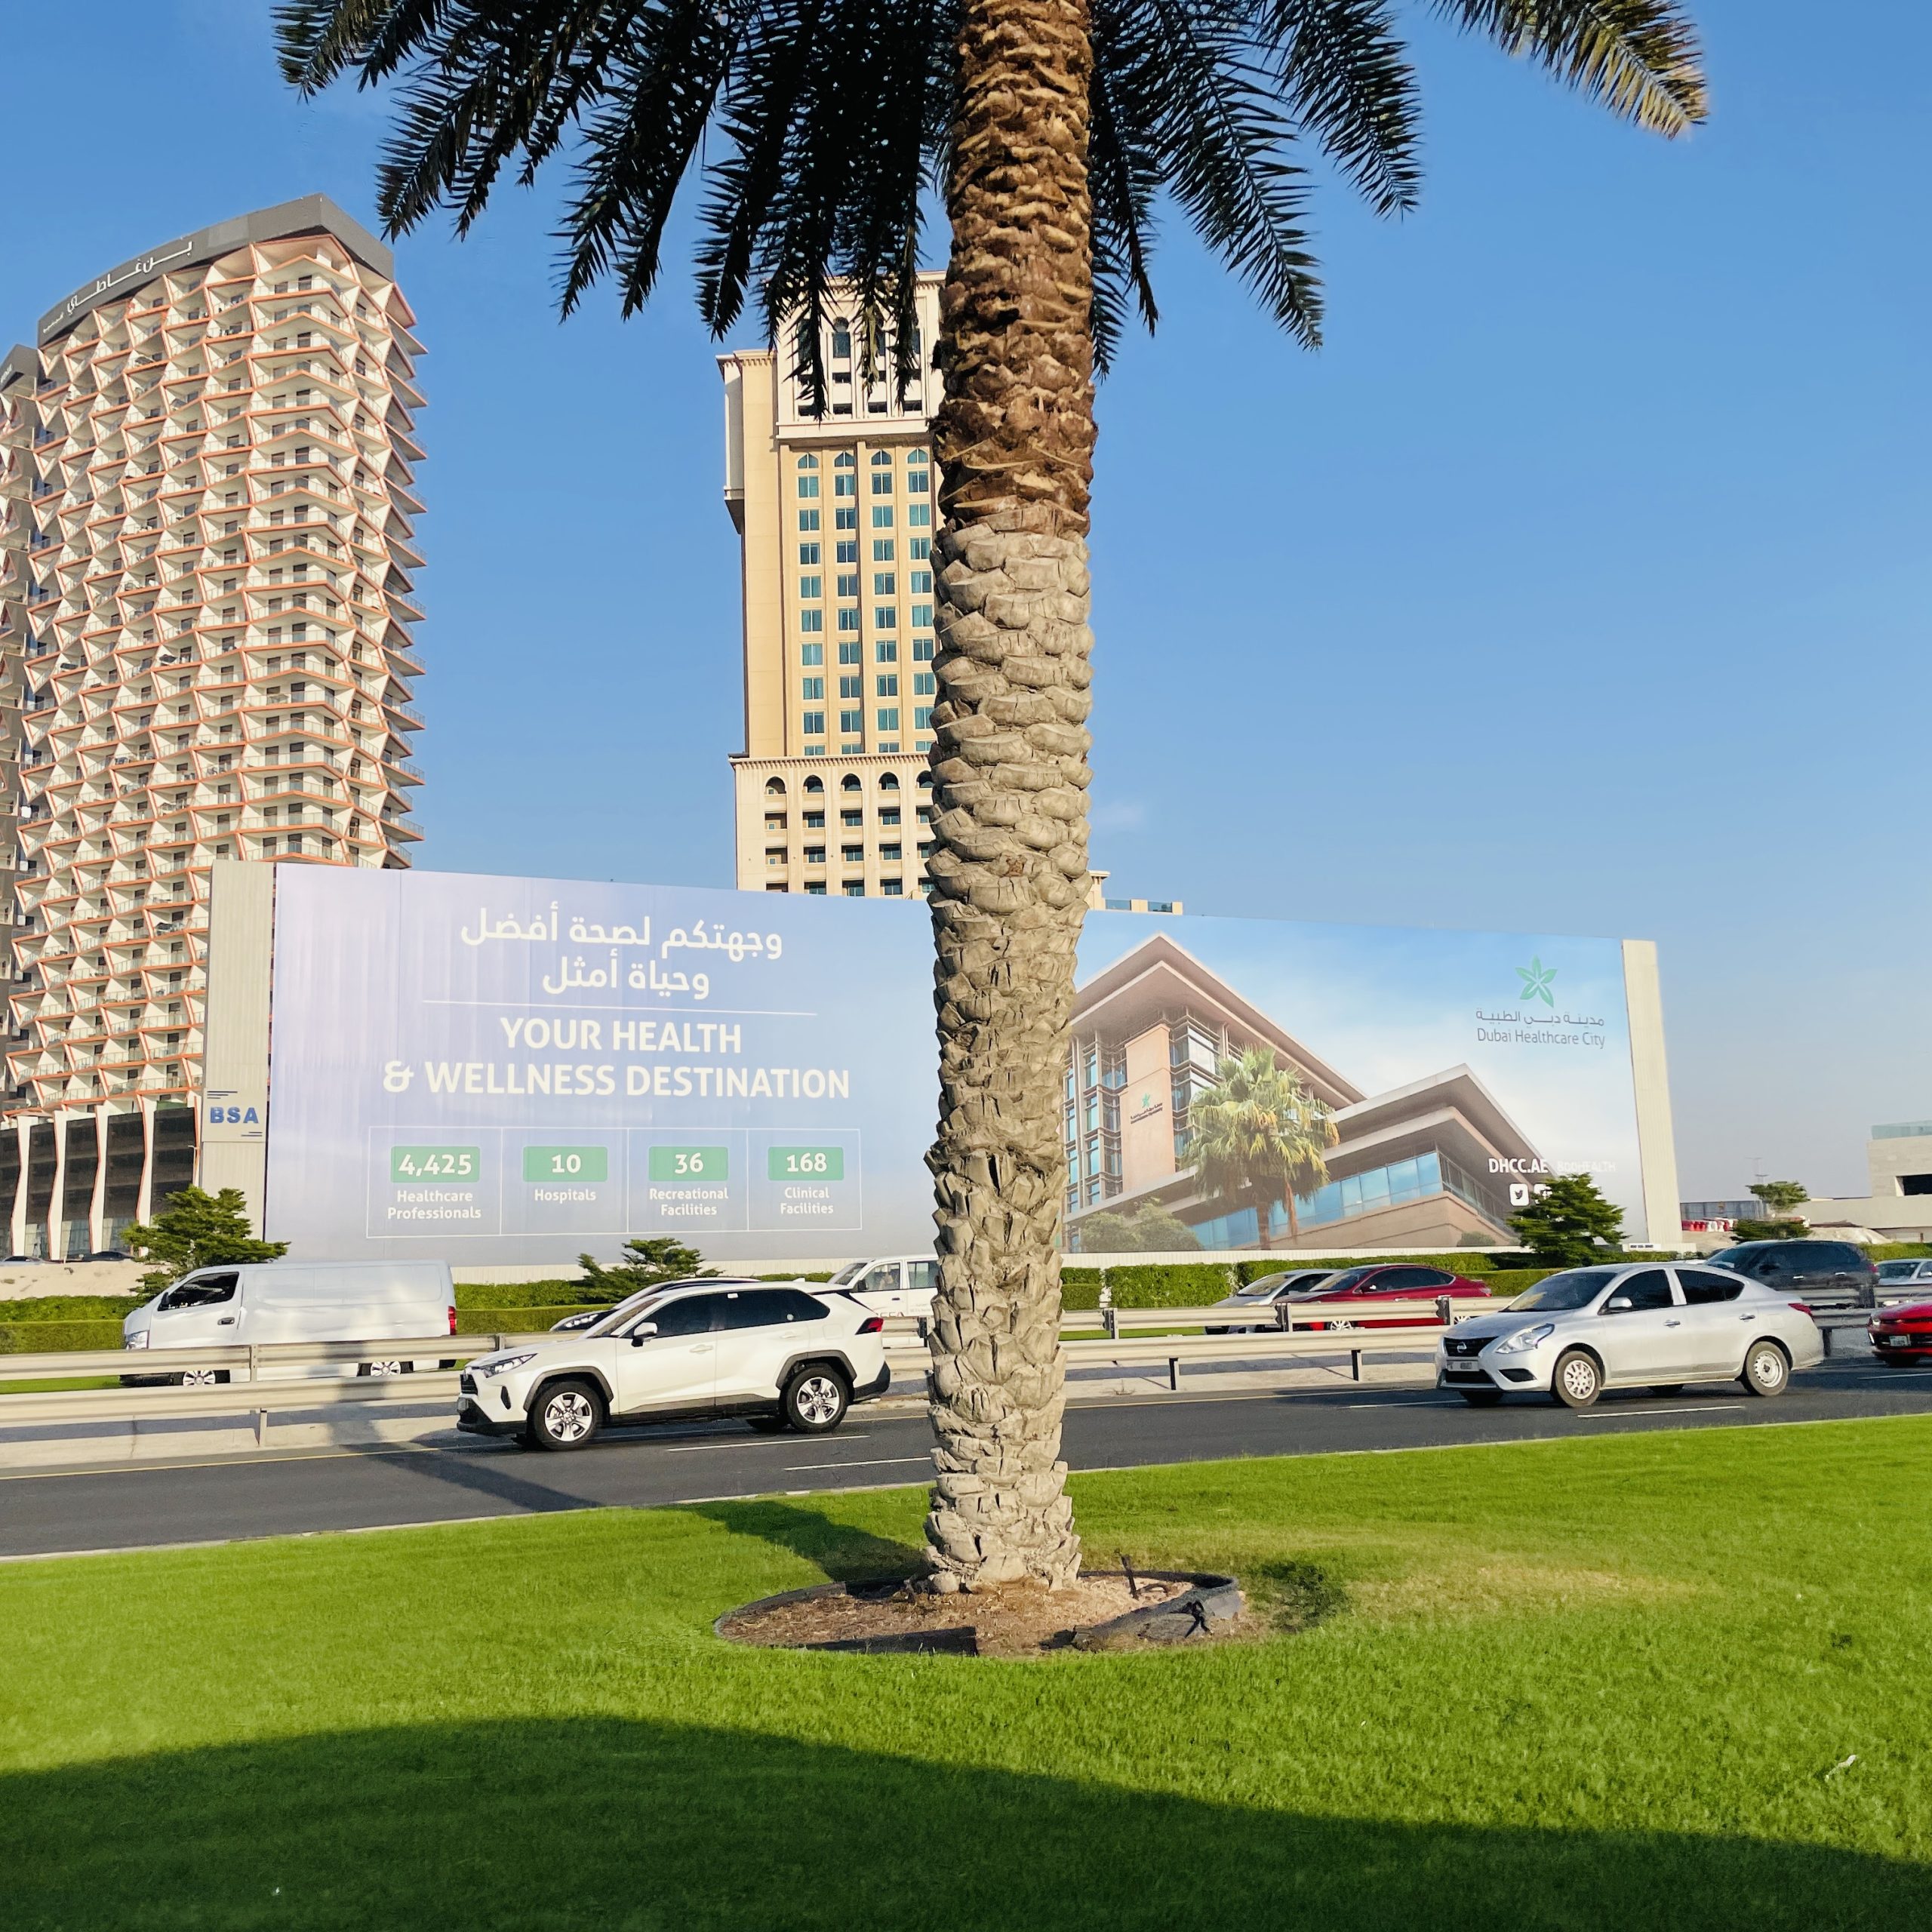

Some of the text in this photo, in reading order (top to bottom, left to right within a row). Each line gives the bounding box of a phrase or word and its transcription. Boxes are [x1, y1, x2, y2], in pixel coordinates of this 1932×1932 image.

[461, 901, 783, 961] وجهتكم لصحة أفضل
[543, 949, 709, 999] وحياة أمثل
[500, 1017, 741, 1053] YOUR HEALTH
[1477, 1027, 1605, 1049] Dubai Healthcare City
[383, 1060, 851, 1099] & WELLNESS DESTINATION
[210, 1106, 259, 1124] BSA
[398, 1154, 472, 1177] 4,425
[551, 1154, 581, 1174] 10
[675, 1152, 704, 1174] 36
[786, 1152, 828, 1173] 168
[1488, 1158, 1548, 1174] DHCC.AE
[397, 1189, 473, 1202] Healthcare
[534, 1188, 596, 1203] Hospitals
[649, 1187, 728, 1201] Recreational
[784, 1186, 829, 1199] Clinical
[388, 1205, 481, 1220] Professionals
[660, 1202, 717, 1216] Facilities
[780, 1201, 834, 1215] Facilities
